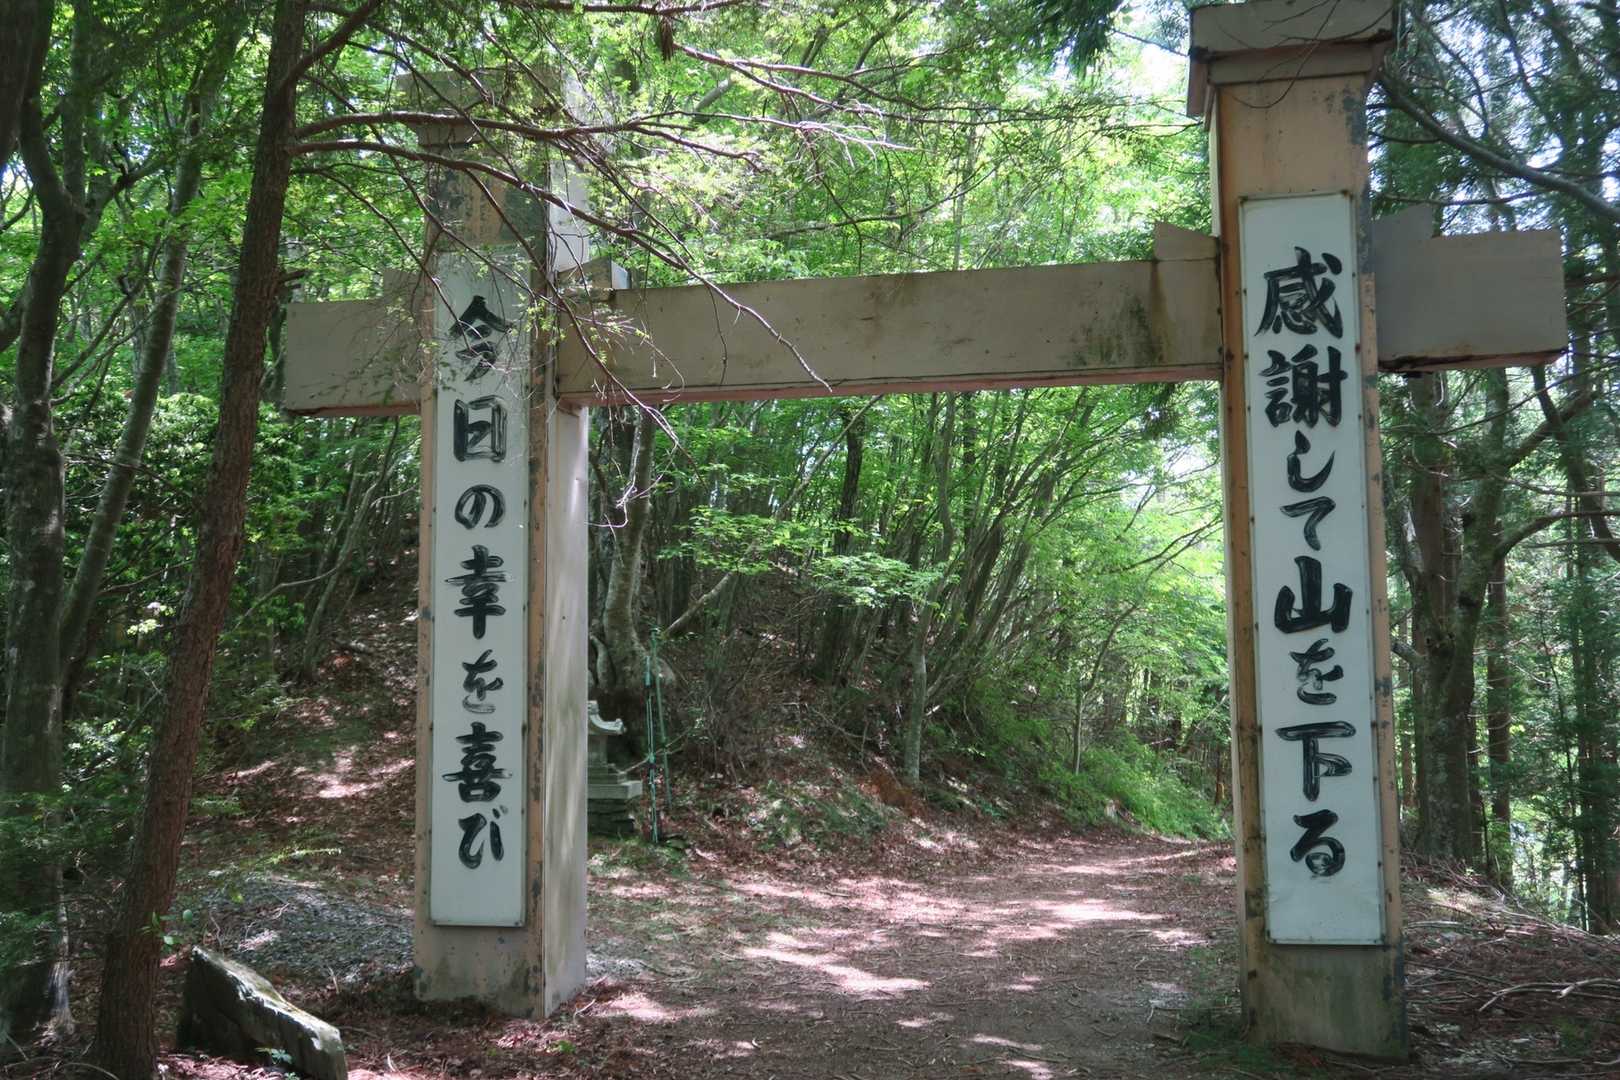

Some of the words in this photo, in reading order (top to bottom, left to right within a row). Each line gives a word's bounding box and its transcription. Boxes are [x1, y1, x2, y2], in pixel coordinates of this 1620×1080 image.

[442, 296, 514, 869] 今日の幸を喜び
[1255, 246, 1356, 878] 感謝して山を下る
